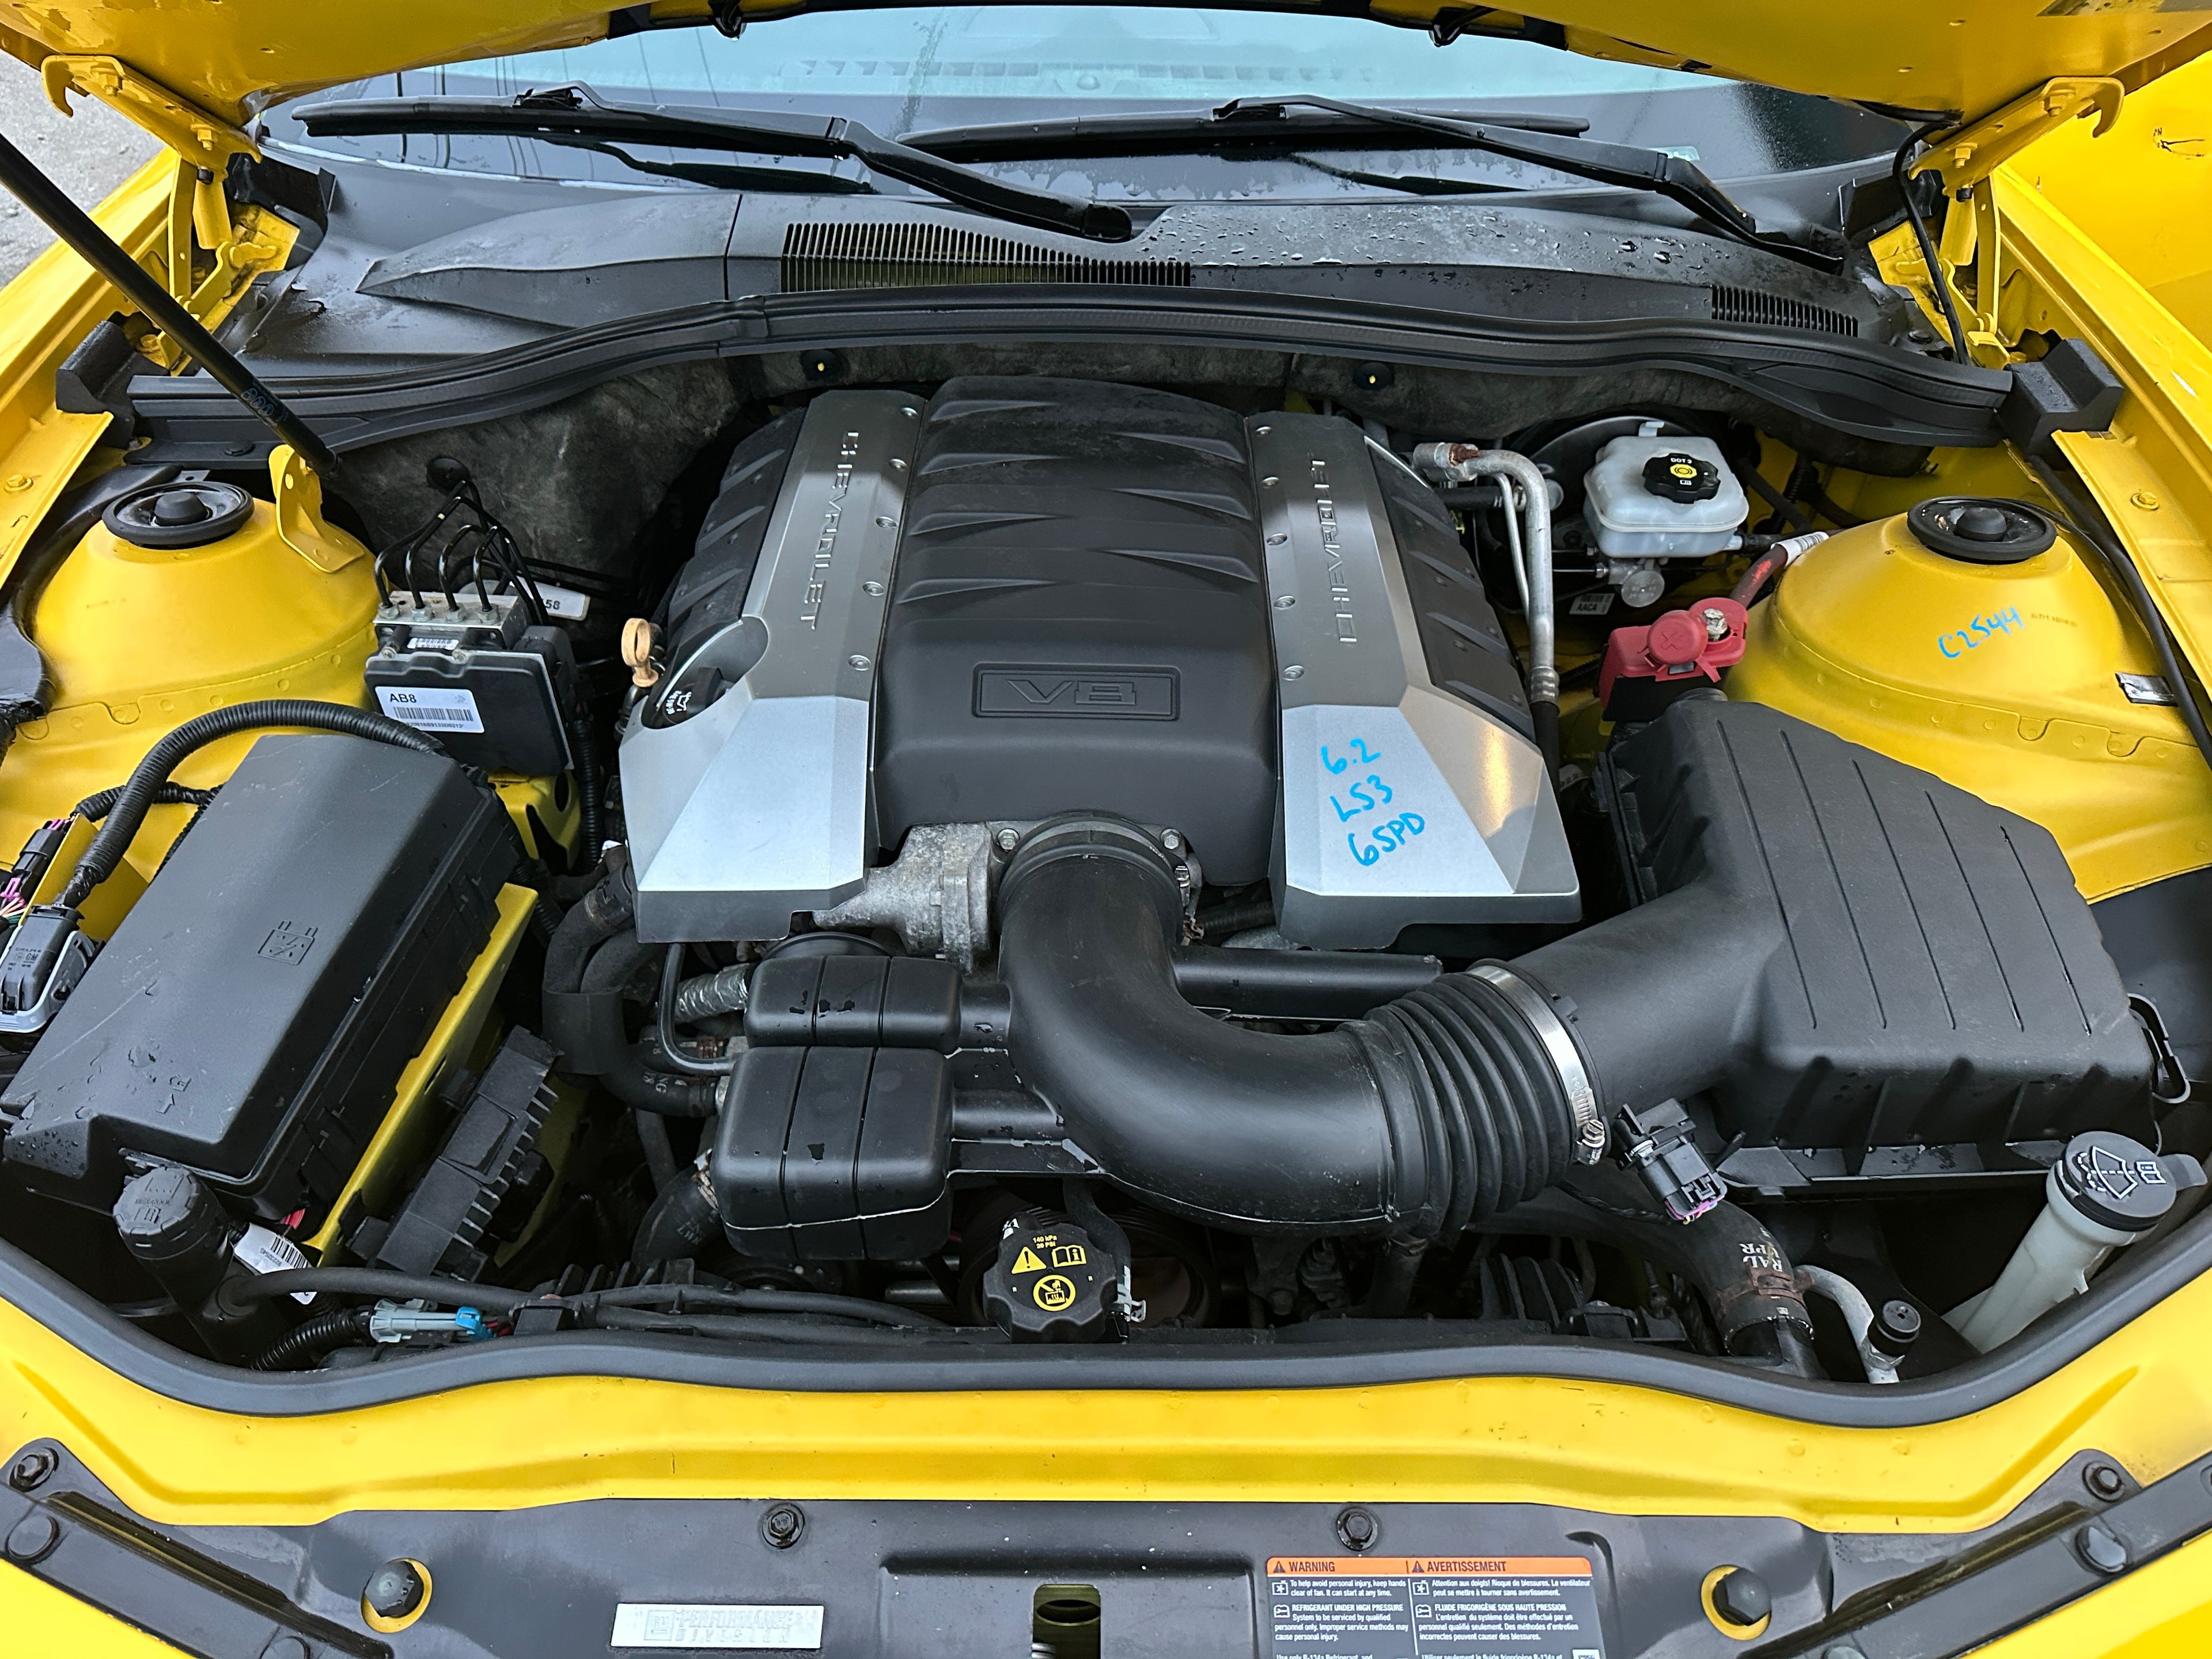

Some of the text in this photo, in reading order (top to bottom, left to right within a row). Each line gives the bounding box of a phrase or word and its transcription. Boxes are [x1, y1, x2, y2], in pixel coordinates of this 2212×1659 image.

[801, 431, 859, 630] CHEVROLET
[1307, 452, 1357, 642] CHEVROLET
[1938, 605, 2025, 659] C2544
[389, 693, 417, 704] AB8
[1006, 679, 1137, 706] V8
[1321, 738, 1381, 775] 6.2
[1330, 775, 1392, 823] LS3
[1348, 812, 1425, 866] 6SPD
[1289, 1562, 1335, 1572] WARNING
[1427, 1562, 1506, 1571] AVERTISSEMENT
[1471, 1580, 1490, 1588] doigts!
[1491, 1580, 1512, 1588] Risque
[1292, 1614, 1314, 1622] System
[1357, 1614, 1365, 1622] by
[1366, 1614, 1391, 1622] qualified
[1419, 1623, 1447, 1631] personnel
[1453, 1633, 1477, 1641] peuvent
